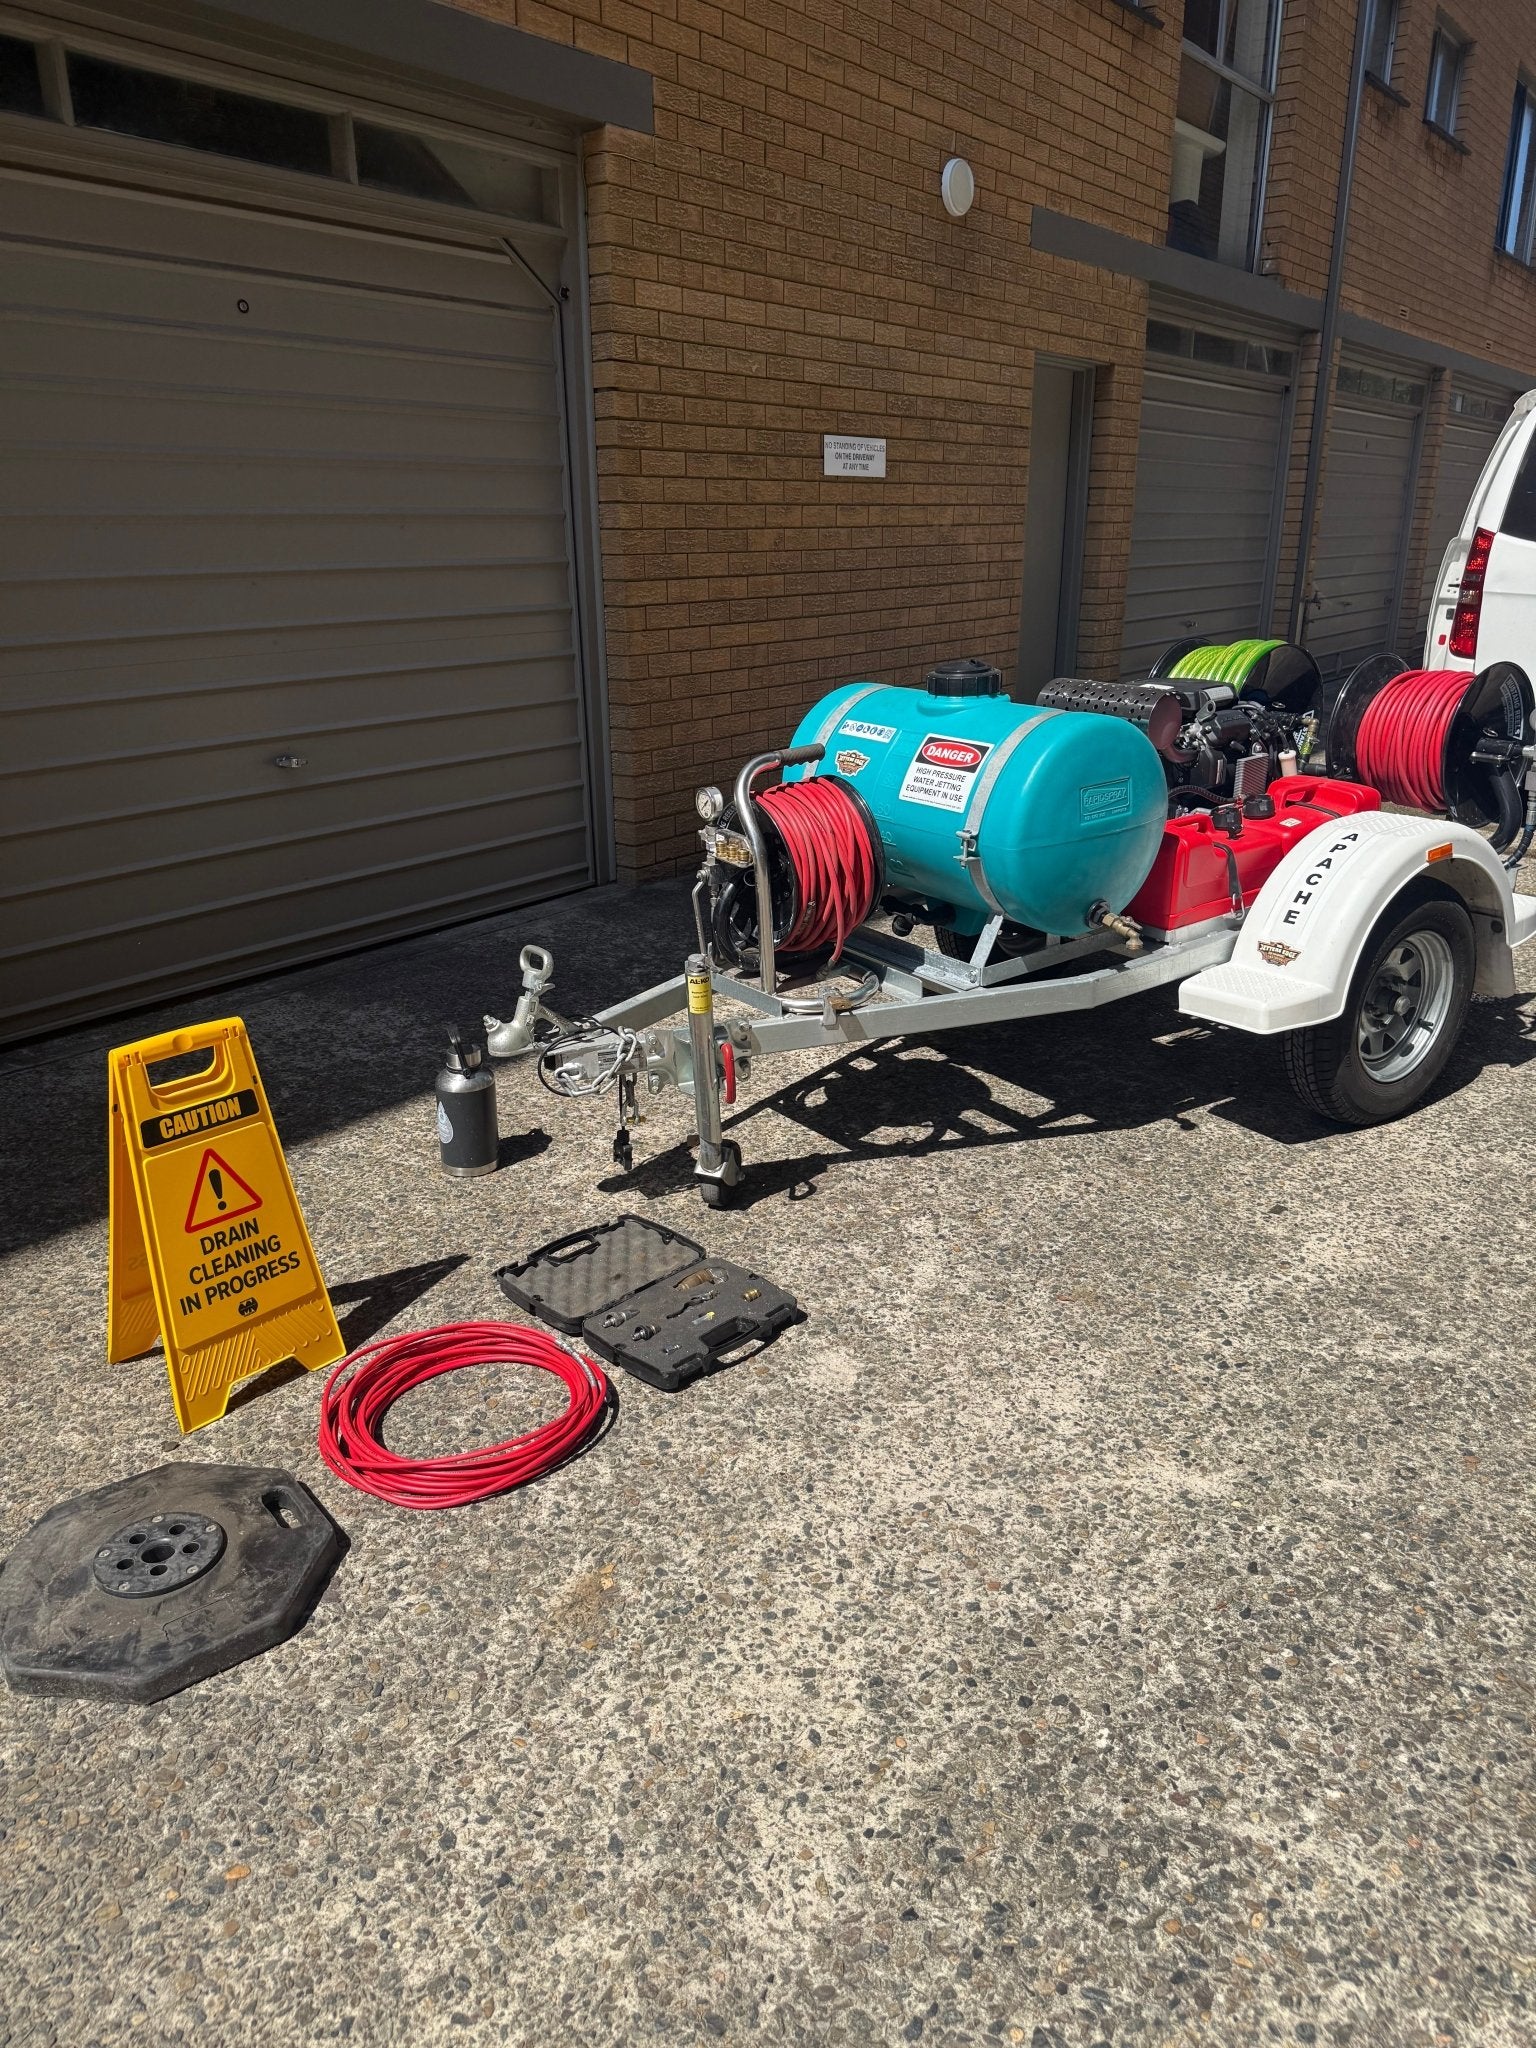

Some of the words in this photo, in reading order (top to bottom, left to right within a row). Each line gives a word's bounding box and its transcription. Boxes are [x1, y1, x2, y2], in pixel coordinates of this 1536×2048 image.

[824, 441, 833, 449] NO
[833, 442, 857, 451] STANDING
[857, 443, 864, 451] OF
[864, 444, 885, 452] VEHICLES
[835, 452, 842, 460] ON
[852, 453, 875, 461] DRIVEWAY
[849, 463, 859, 471] ANY
[926, 745, 974, 763] DANGER
[913, 776, 934, 786] WATER
[934, 779, 962, 792] JETTING
[916, 767, 932, 775] HIGH
[931, 770, 966, 783] PRESSURE
[905, 784, 941, 798] EQUIPMENT
[941, 791, 949, 799] IN
[949, 793, 963, 802] USE
[1283, 833, 1358, 925] APACHE
[690, 977, 710, 985] AL-KO
[159, 1097, 242, 1139] CAUTION
[200, 1217, 260, 1255] DRAIN
[189, 1234, 281, 1285] CLEANING
[180, 1292, 202, 1316] IN
[204, 1251, 300, 1305] PROGRESS
